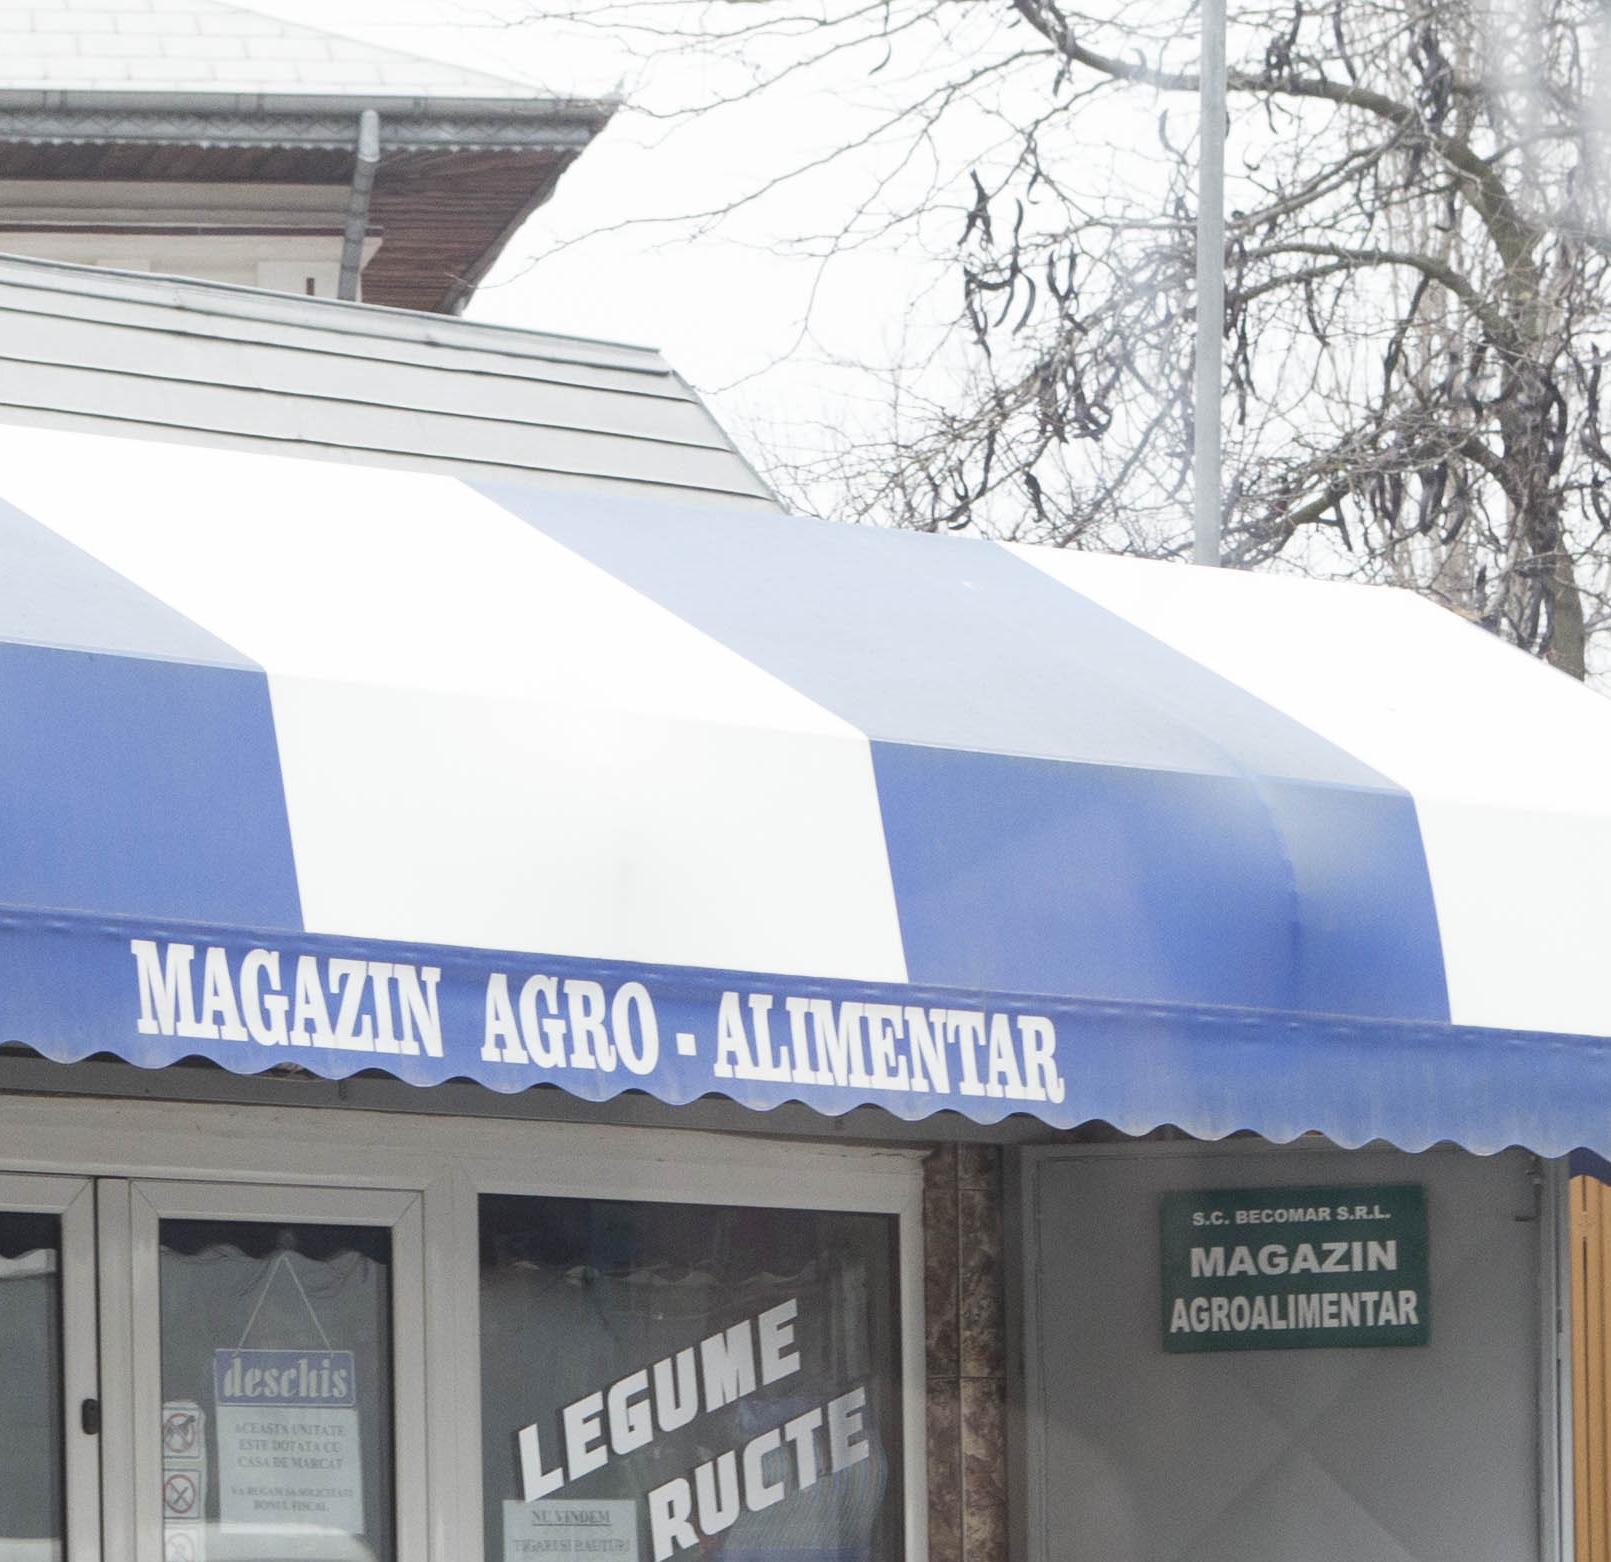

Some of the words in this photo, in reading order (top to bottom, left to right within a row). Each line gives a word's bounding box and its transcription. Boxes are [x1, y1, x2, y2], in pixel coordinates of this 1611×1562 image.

[131, 938, 443, 1058] MAGAZIN
[481, 972, 659, 1076] AGRO
[713, 991, 1065, 1104] ALIMENTAR
[1192, 1210, 1230, 1226] S.C.
[1235, 1206, 1332, 1225] BECOMAR
[1336, 1204, 1392, 1221] S.R.L.
[1190, 1239, 1398, 1278] MAGAZIN
[1169, 1289, 1420, 1334] AGROALIMENTAR
[222, 1356, 349, 1399] deschis
[518, 1298, 801, 1504] LEGUME
